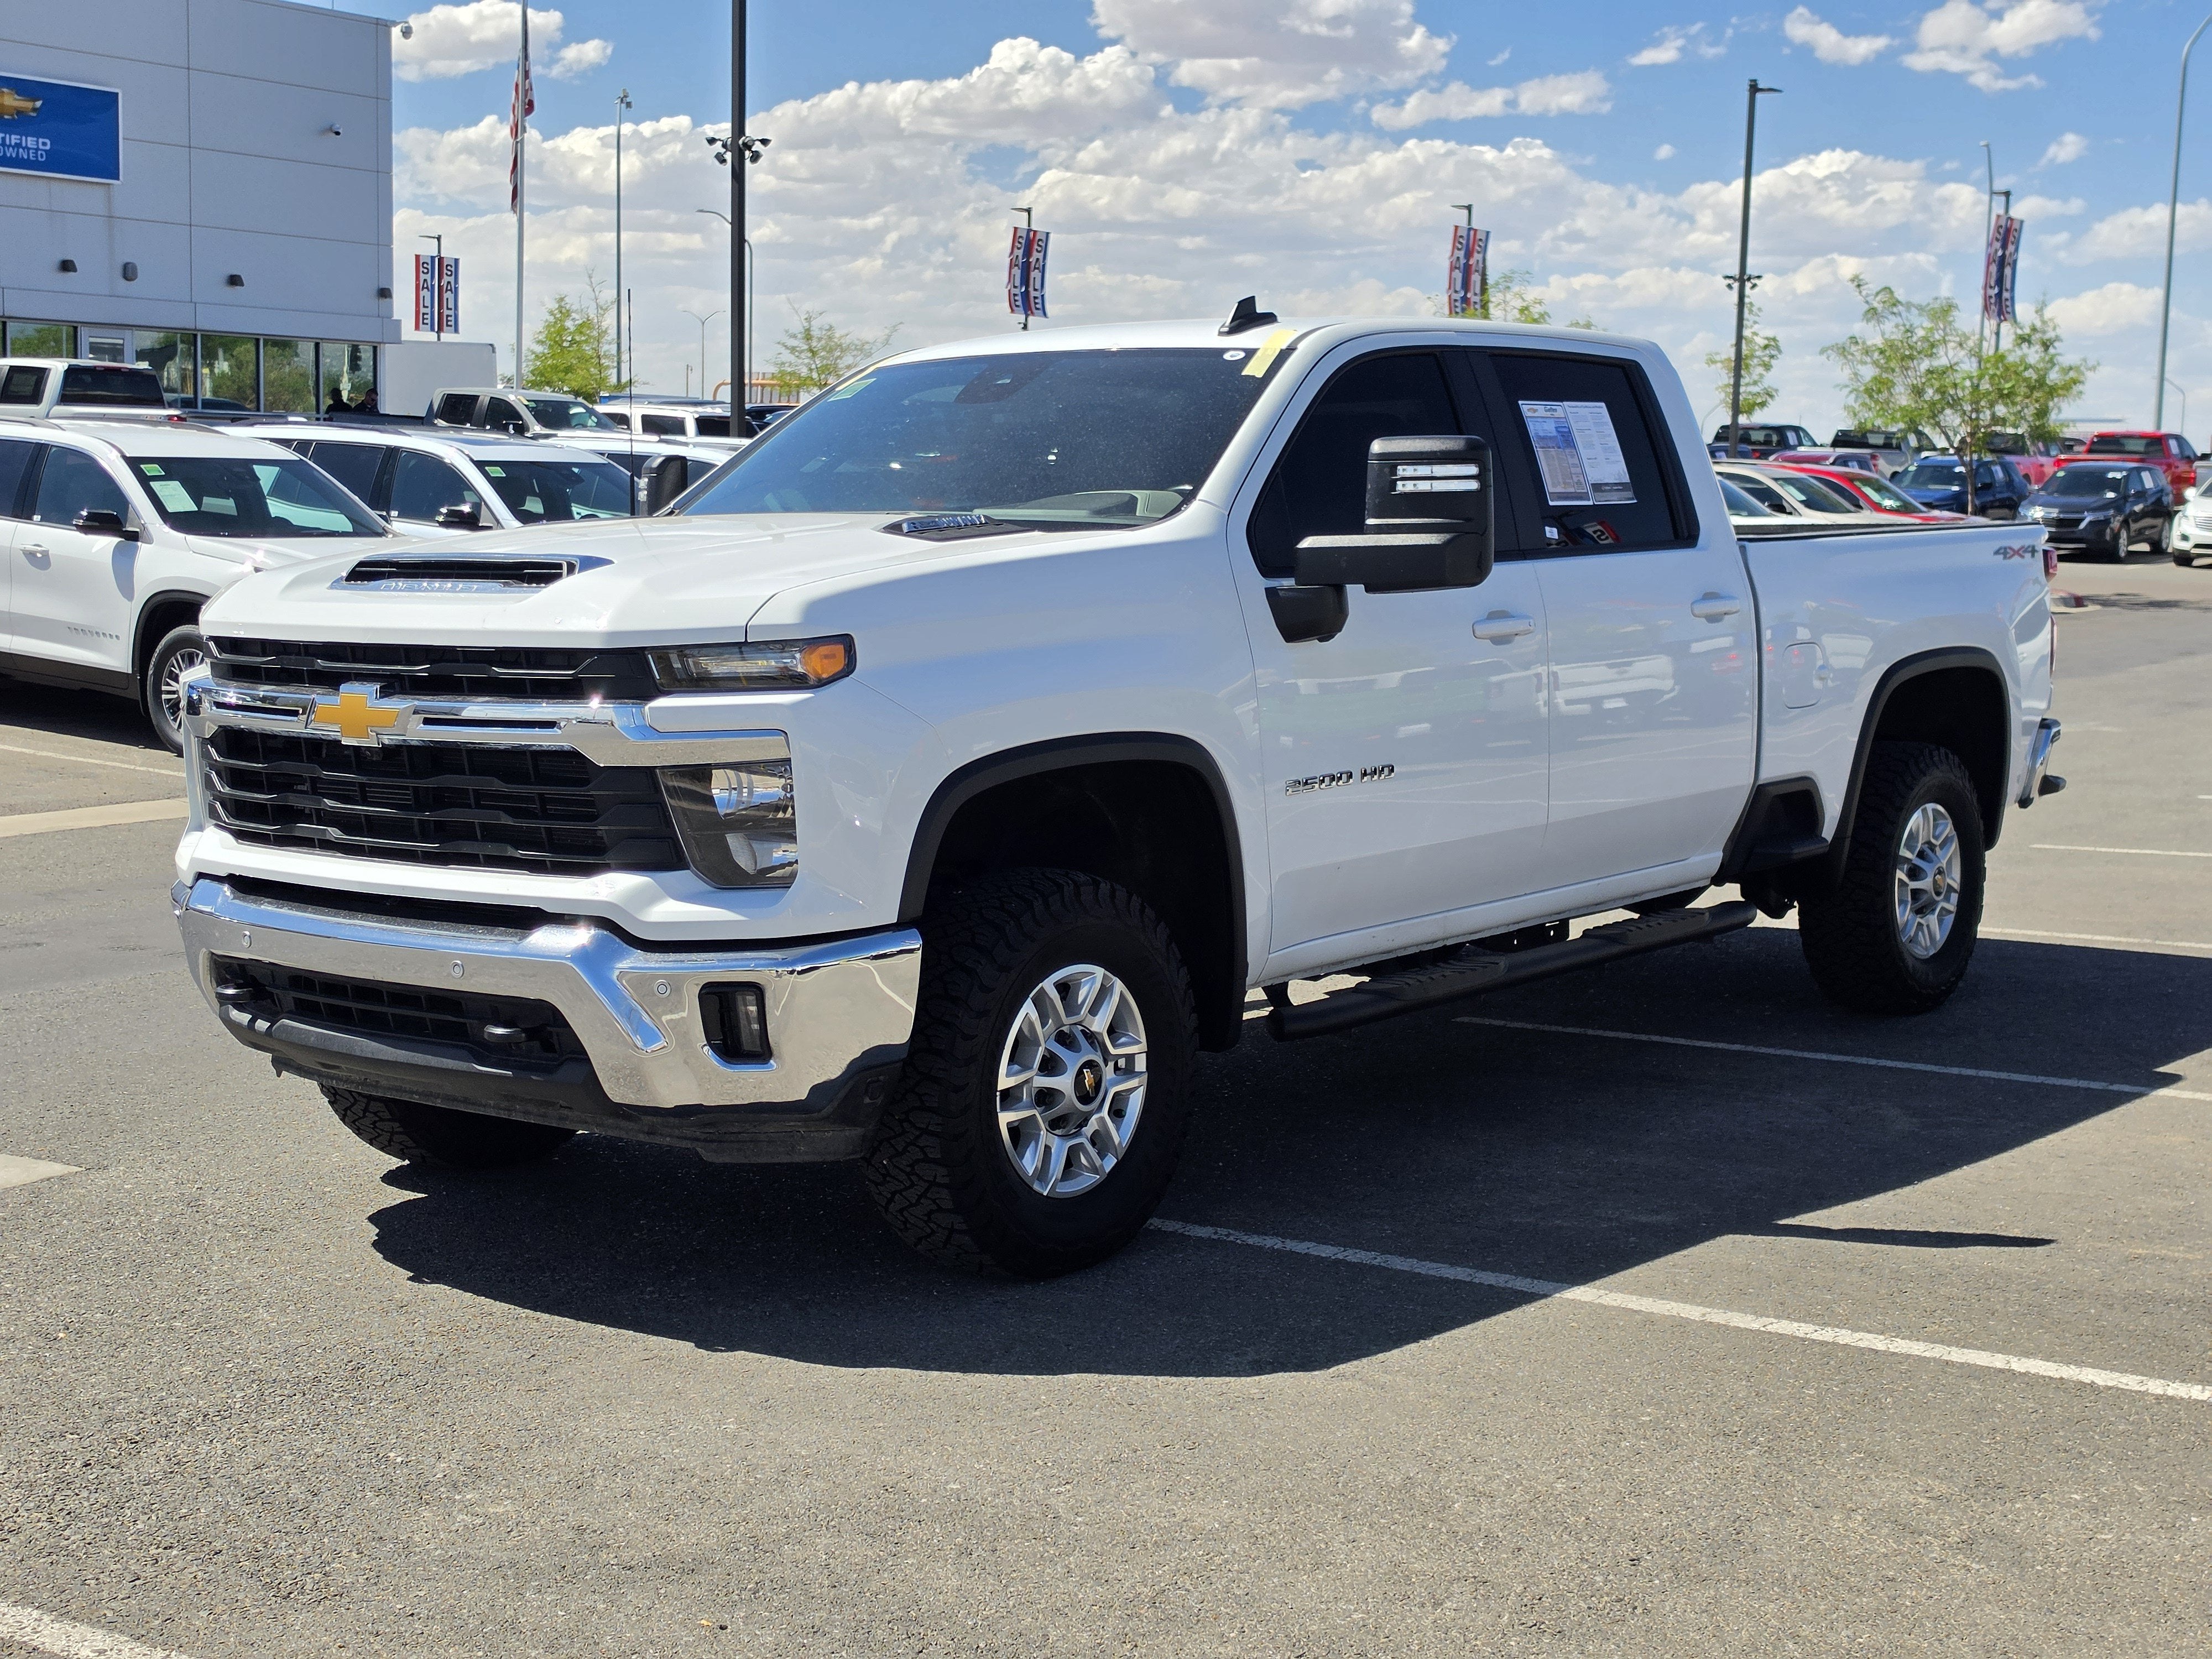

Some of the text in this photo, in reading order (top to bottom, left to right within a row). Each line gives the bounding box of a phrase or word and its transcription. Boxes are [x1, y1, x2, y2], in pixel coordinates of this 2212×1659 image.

[421, 262, 430, 325] SALE
[445, 264, 453, 327] SALE
[1012, 235, 1025, 308] SALE
[1031, 238, 1044, 311] SALE
[1453, 234, 1465, 314] SALE
[1285, 763, 1395, 796] 2500 HD
